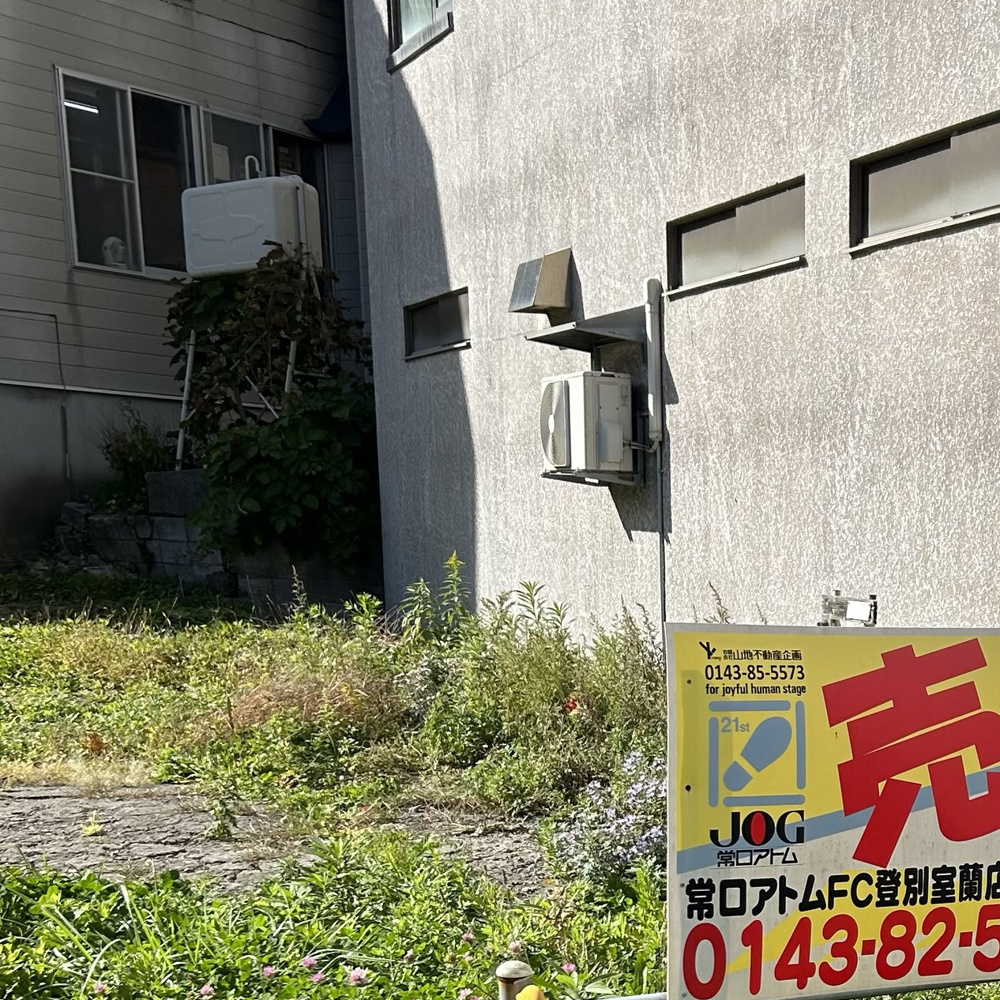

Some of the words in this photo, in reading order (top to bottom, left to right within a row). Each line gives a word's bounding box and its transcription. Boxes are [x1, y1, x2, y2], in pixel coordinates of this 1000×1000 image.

[705, 664, 805, 680] 0143-85-5573
[705, 684, 719, 694] for
[722, 683, 748, 697] joyful
[751, 683, 780, 694] human
[783, 684, 806, 696] stage
[721, 716, 750, 733] 21st
[709, 810, 804, 847] JOG
[717, 847, 798, 867] 常口アトム
